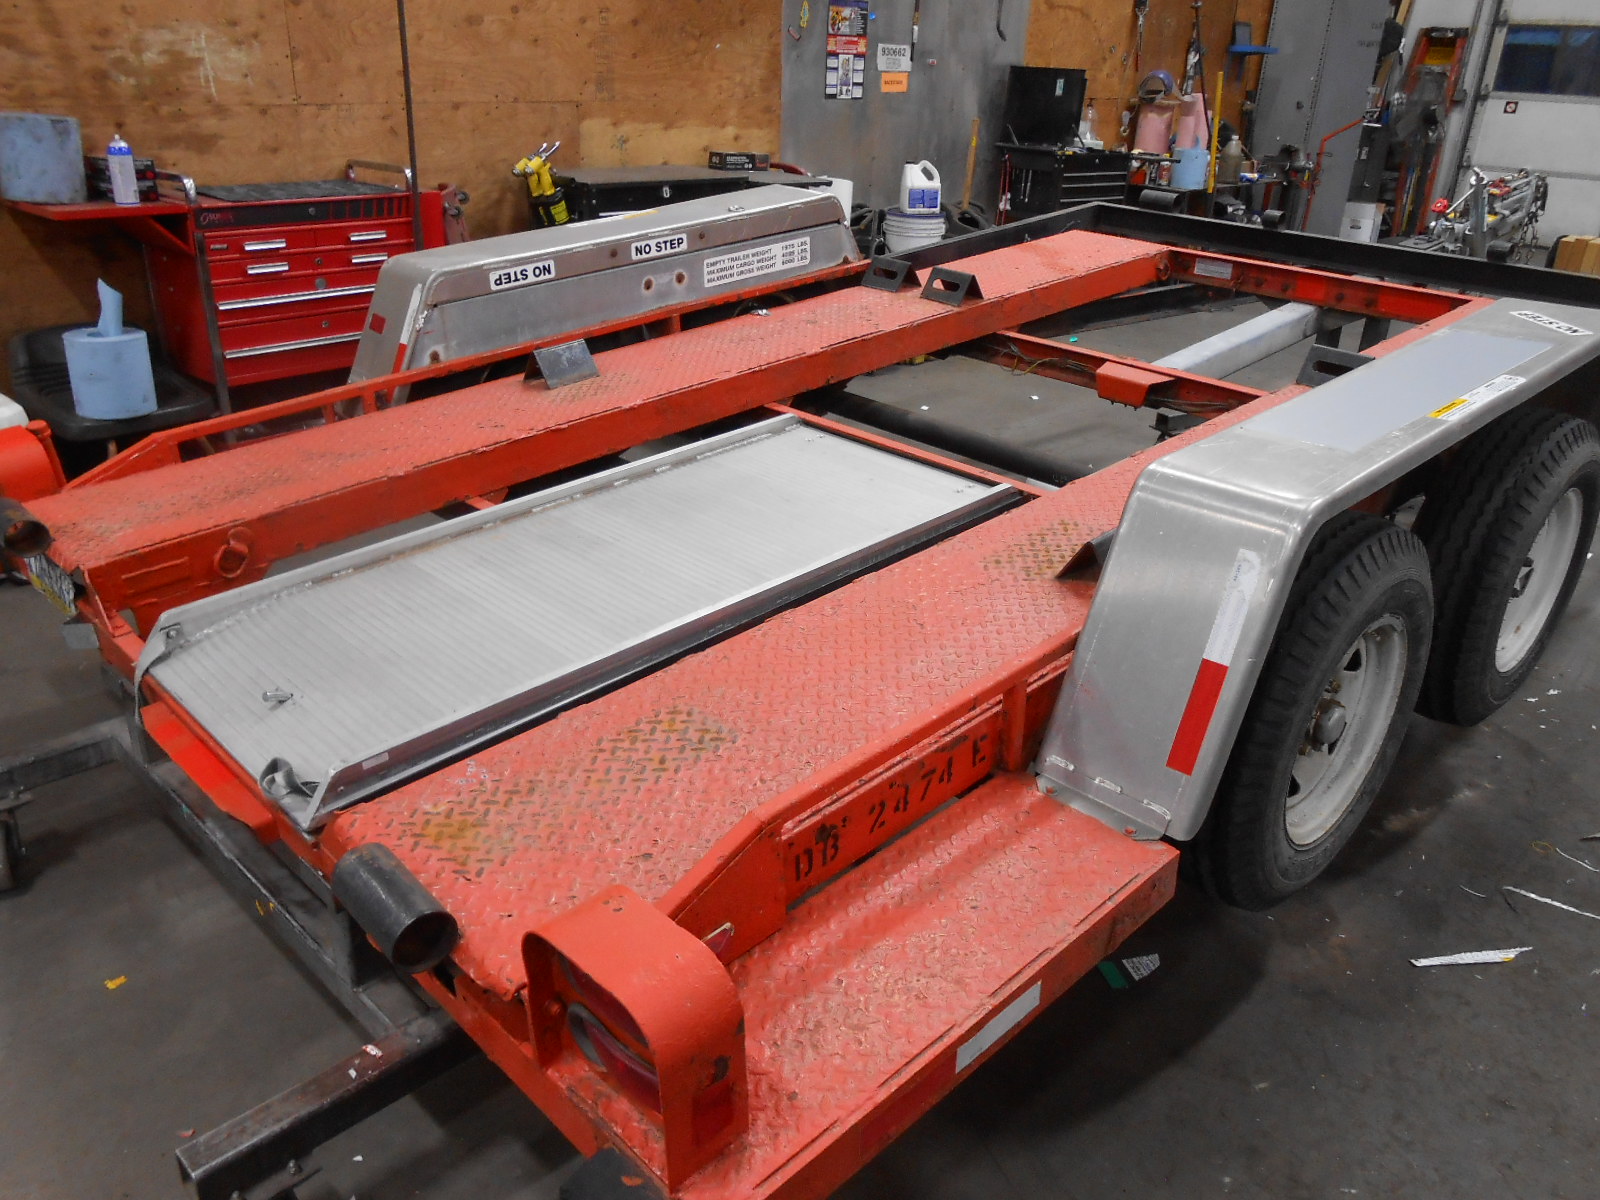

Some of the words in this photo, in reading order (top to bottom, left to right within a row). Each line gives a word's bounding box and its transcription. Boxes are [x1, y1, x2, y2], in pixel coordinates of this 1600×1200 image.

[881, 47, 906, 57] 930662
[634, 243, 652, 257] NO
[655, 237, 684, 253] STEP
[706, 260, 725, 268] EMPTY
[727, 254, 750, 263] TRAILER
[751, 249, 772, 258] WEIGHT
[706, 265, 735, 275] MAXIMUM
[736, 260, 755, 268] CARGO
[757, 255, 777, 264] WEIGHT
[494, 269, 528, 287] STEP
[533, 263, 552, 278] NO
[706, 272, 735, 283] MAXIMUM
[736, 267, 755, 276] GROSS
[756, 262, 777, 272] WEIGHT
